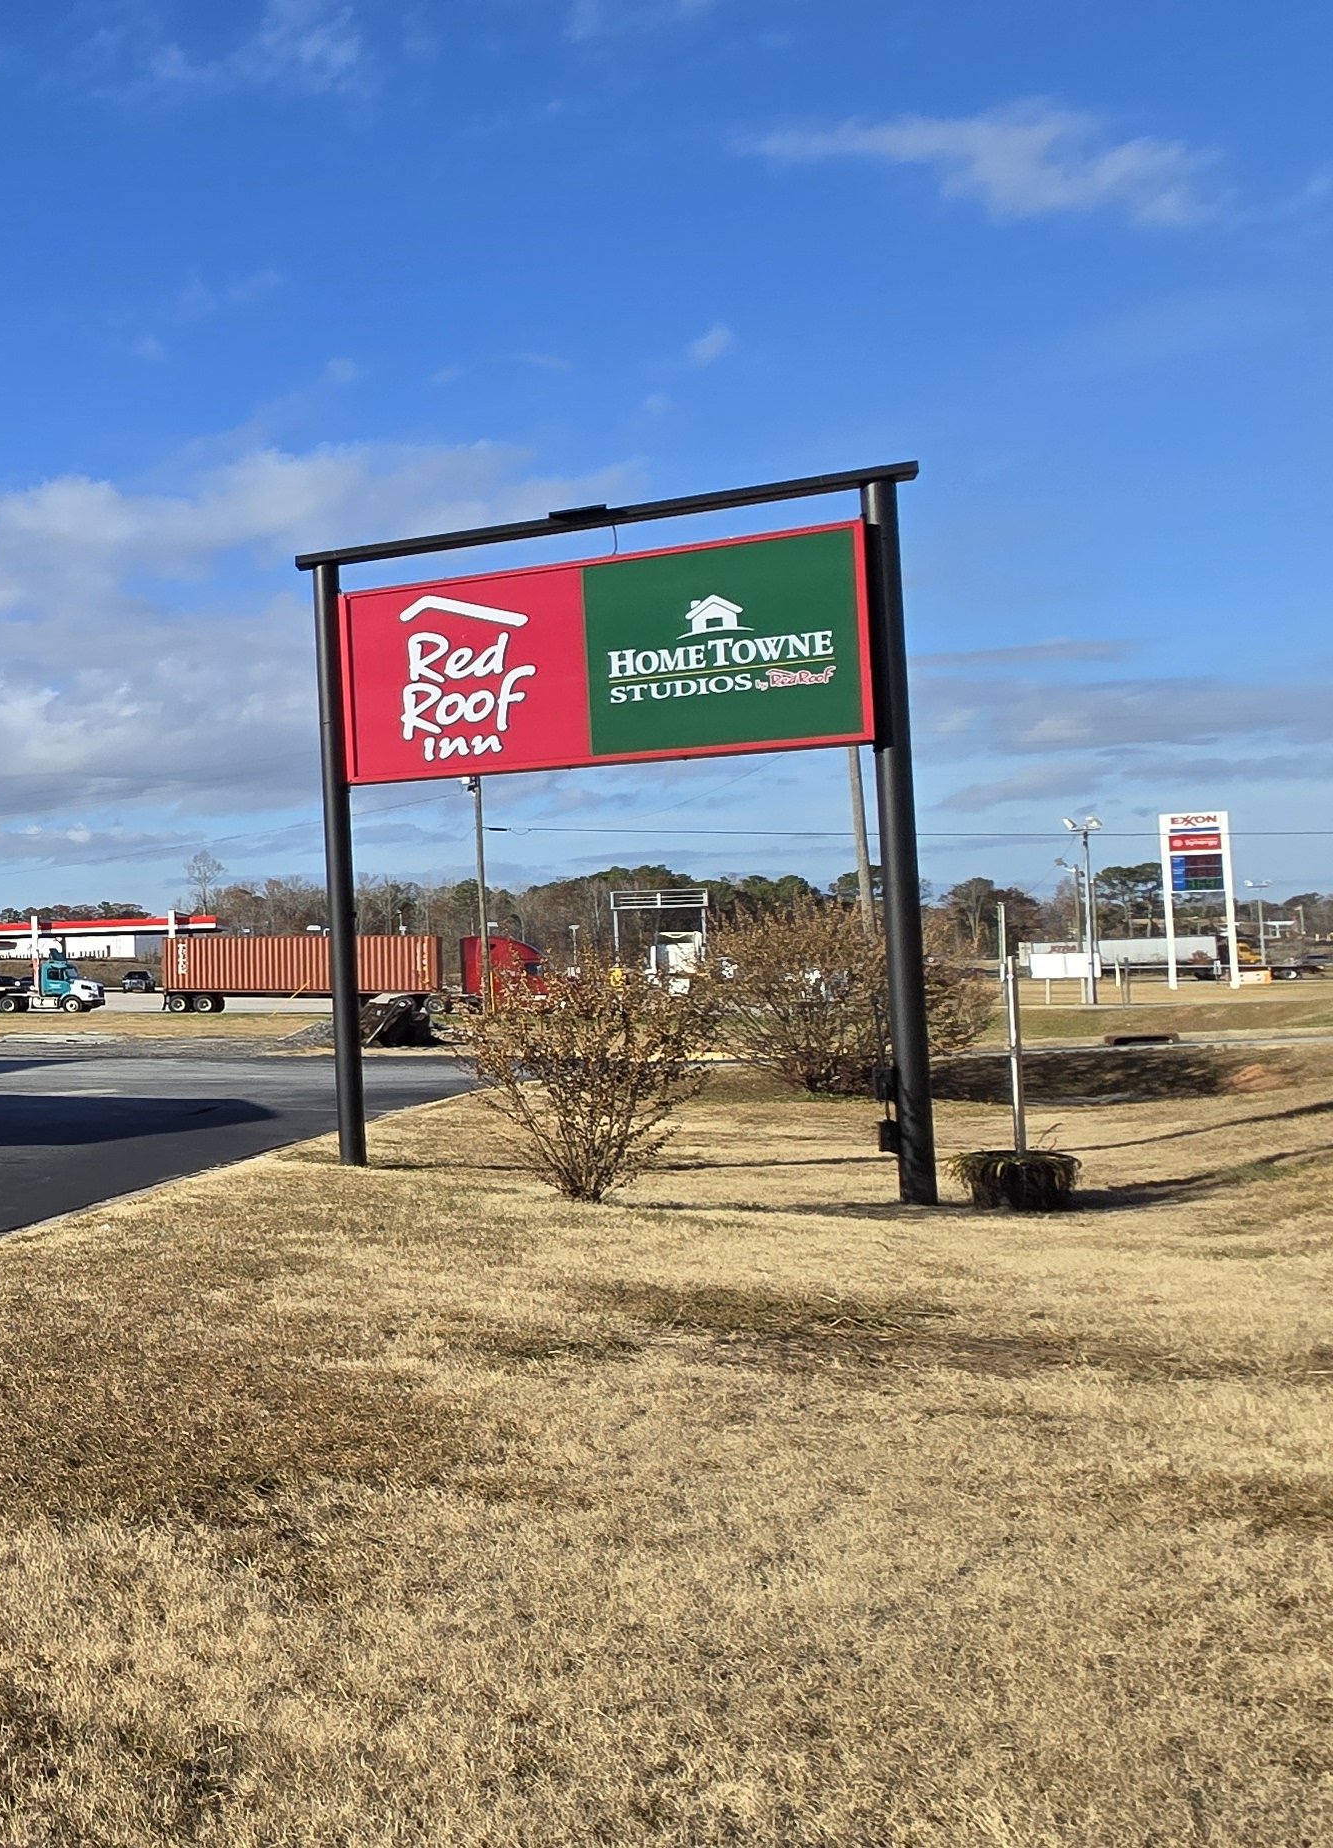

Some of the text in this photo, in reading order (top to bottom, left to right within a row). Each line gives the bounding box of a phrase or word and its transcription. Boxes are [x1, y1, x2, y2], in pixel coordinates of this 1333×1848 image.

[407, 631, 509, 683] Red
[400, 664, 536, 741] Roof
[610, 673, 752, 704] STUDIOS
[755, 679, 769, 691] by
[1170, 815, 1217, 827] EXXON
